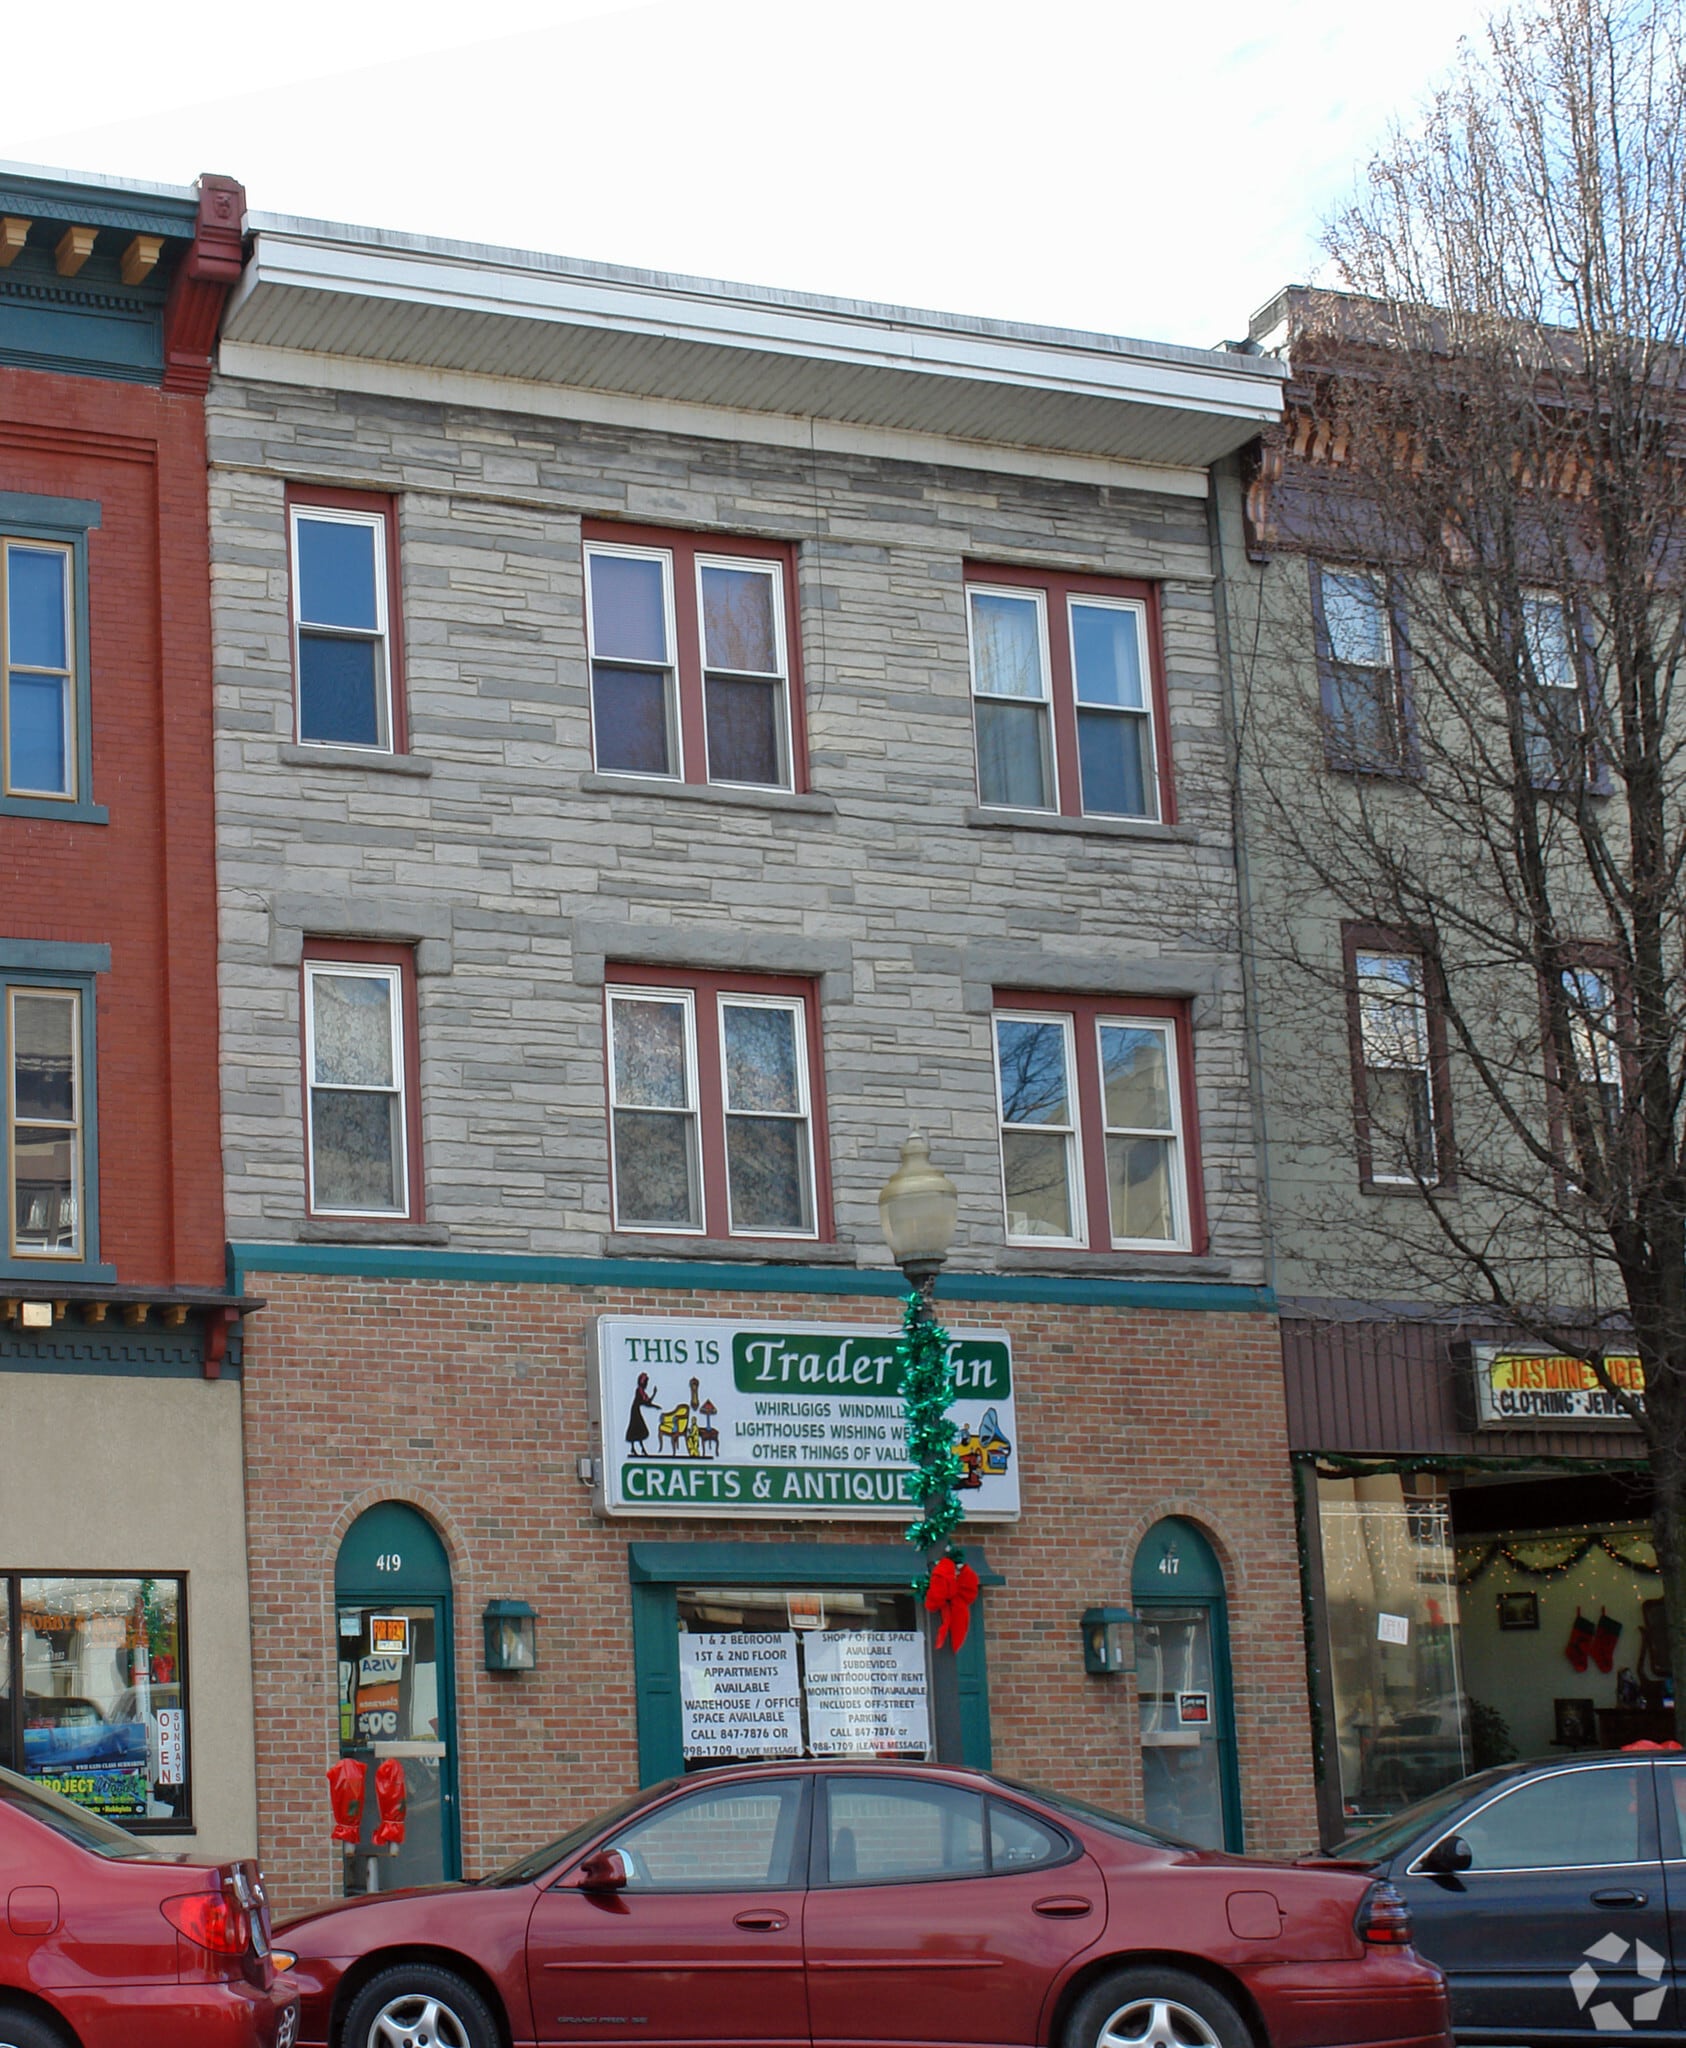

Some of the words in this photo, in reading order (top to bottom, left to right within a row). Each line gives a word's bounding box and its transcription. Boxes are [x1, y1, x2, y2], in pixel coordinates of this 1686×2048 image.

[625, 1337, 688, 1364] THIS
[697, 1339, 720, 1365] IS
[745, 1338, 894, 1384] Trader
[1500, 1390, 1574, 1414] CLOTHING
[755, 1401, 831, 1417] WHIRLIGIGS
[839, 1403, 905, 1419] WINDMILL
[735, 1422, 826, 1439] LIGHTHOUSES
[830, 1424, 887, 1440] WISHING
[752, 1443, 797, 1460] OTHER
[801, 1445, 849, 1460] THINGS
[853, 1446, 871, 1460] OF
[875, 1447, 909, 1461] VALU
[626, 1467, 742, 1498] CRAFTS
[752, 1470, 771, 1498] &
[783, 1471, 912, 1501] ANTIQUE
[376, 1553, 402, 1571] 419
[1158, 1558, 1180, 1574] 417
[709, 1634, 716, 1645] &
[720, 1634, 727, 1644] 2
[731, 1634, 782, 1644] BEDROOM
[822, 1633, 847, 1642] SHOP
[855, 1633, 885, 1642] OFFICE
[888, 1633, 915, 1642] SPACE
[695, 1651, 713, 1661] 1ST
[716, 1651, 724, 1661] &
[728, 1650, 749, 1661] 2ND
[752, 1650, 787, 1660] FLOOR
[846, 1646, 892, 1655] AVAILABLE
[843, 1660, 897, 1669] SUBDEVIDED
[704, 1667, 779, 1677] APPARTMENTS
[808, 1673, 828, 1683] LOW
[830, 1672, 898, 1682] INTRODUCTORY
[901, 1673, 924, 1681] RENT
[714, 1682, 770, 1693] AVAILABLE
[684, 1699, 751, 1710] WAREHOUSE
[765, 1697, 800, 1709] OFFICE
[820, 1700, 861, 1709] INCLUDES
[864, 1700, 915, 1709] OFF-STREET
[692, 1712, 725, 1723] SPACE
[729, 1711, 785, 1723] AVAILABLE
[848, 1714, 887, 1723] PARKING
[691, 1729, 717, 1740] CALL
[720, 1728, 769, 1739] 847-7876
[773, 1728, 789, 1738] OR
[830, 1728, 852, 1737] CALL
[854, 1727, 895, 1737] 847-7876
[159, 1712, 171, 1784] OPEN
[173, 1711, 182, 1782] SUNDAYS
[735, 1747, 760, 1755] LEAVE
[763, 1746, 798, 1754] MESSAGE
